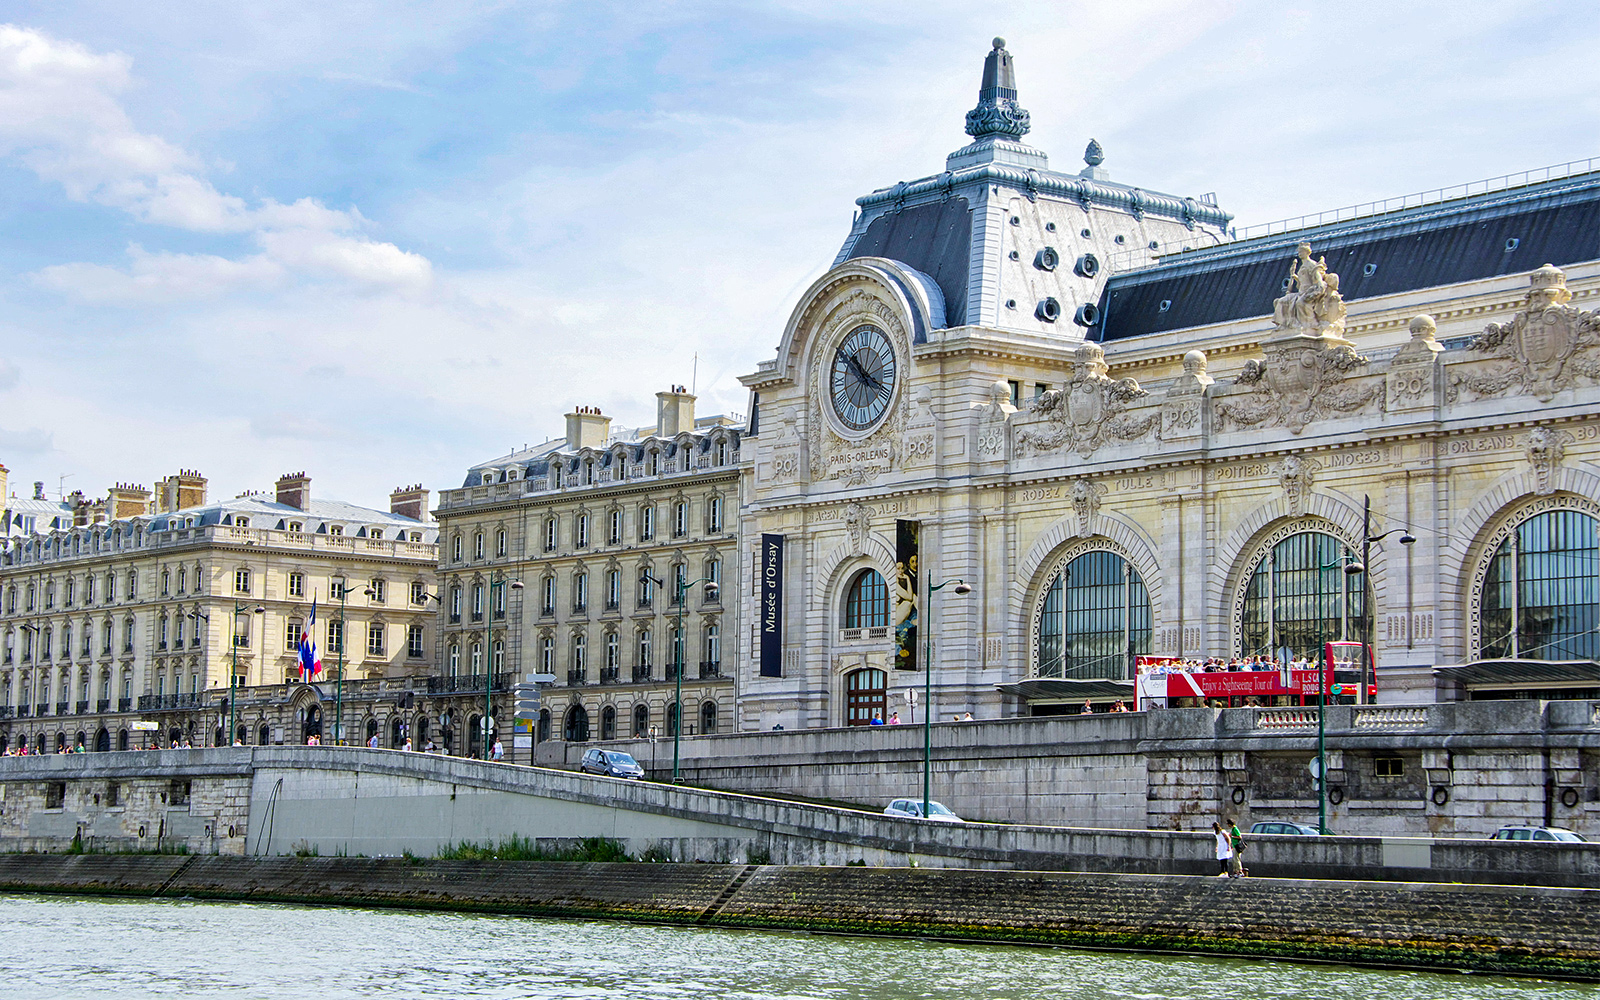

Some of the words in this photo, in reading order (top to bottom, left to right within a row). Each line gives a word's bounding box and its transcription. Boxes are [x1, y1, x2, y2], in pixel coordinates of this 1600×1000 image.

[909, 440, 928, 456] PO
[1451, 435, 1515, 454] ORLEANS
[830, 449, 889, 465] PARIS-ORLEANS
[1323, 450, 1381, 469] LIMOGES
[775, 459, 793, 474] PO
[1216, 463, 1270, 480] POITIERS
[1113, 476, 1153, 491] TULLE
[1022, 487, 1060, 502] RODEZ
[878, 501, 903, 515] ALBI
[766, 542, 779, 589] d'Orsay
[765, 592, 776, 633] Musée
[1201, 677, 1217, 694] Enjoy
[1222, 676, 1253, 694] Sightseeing
[1253, 676, 1266, 690] Tour
[1266, 675, 1274, 690] of
[1302, 683, 1327, 692] ROUGS
